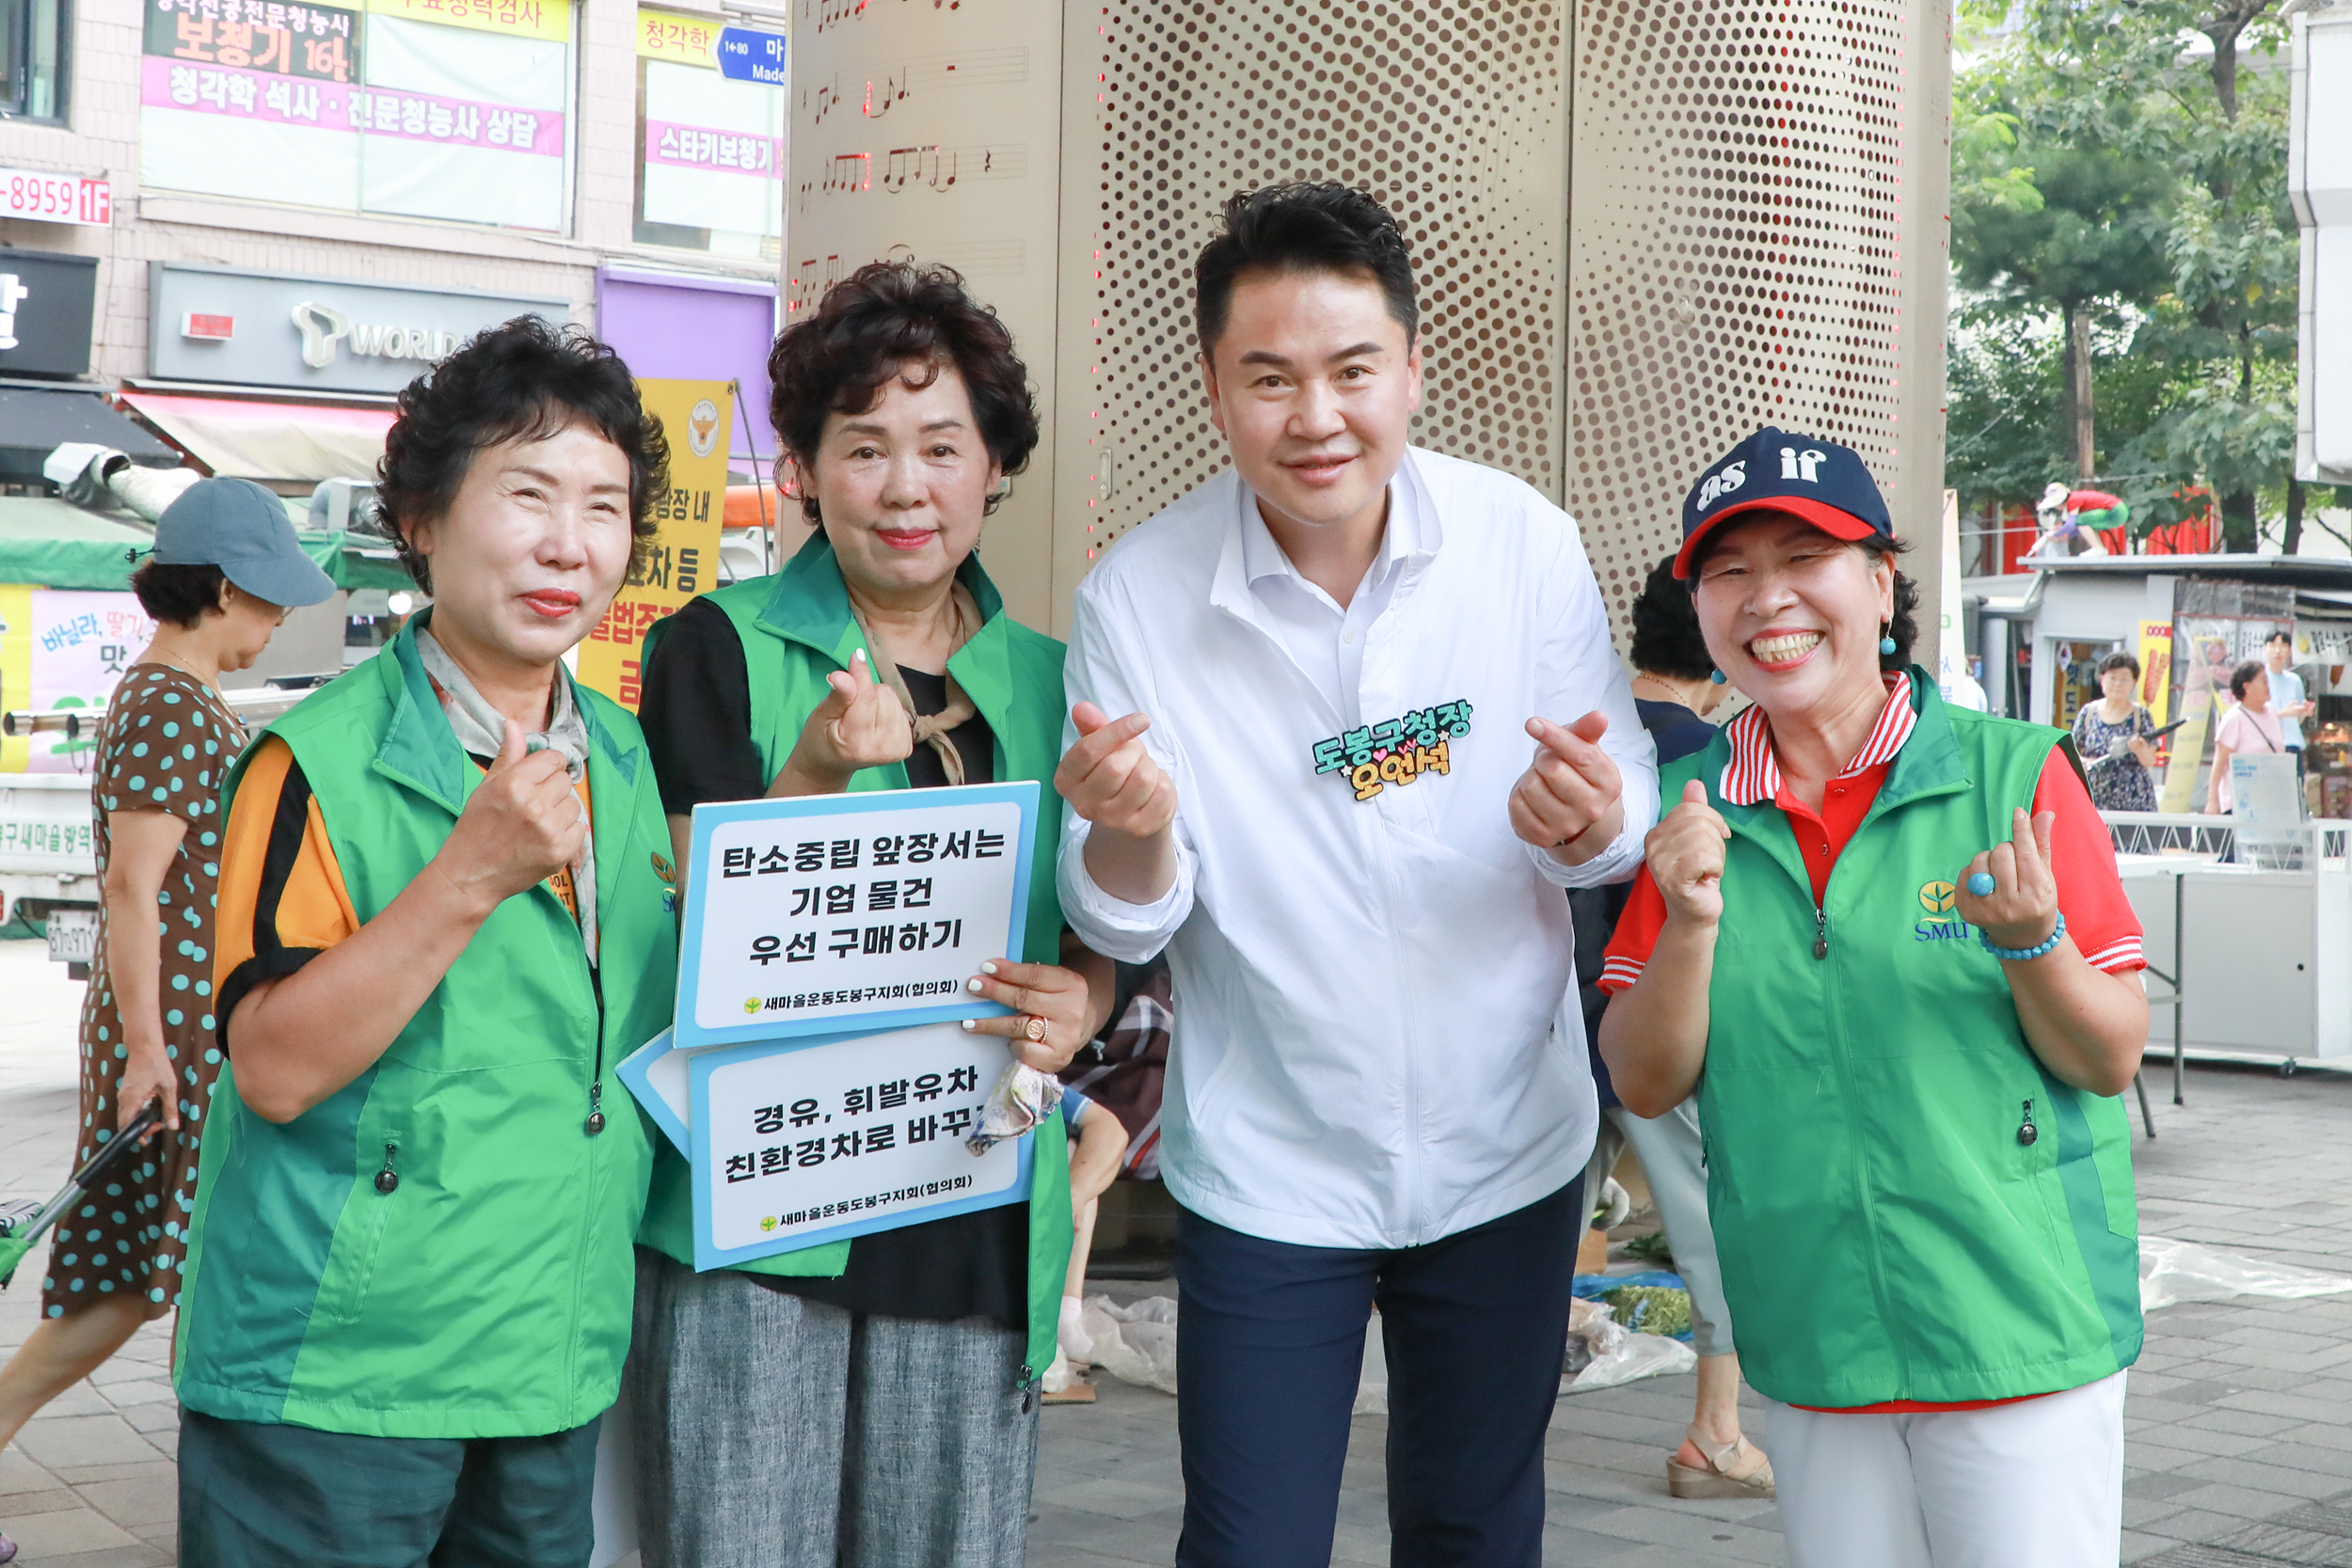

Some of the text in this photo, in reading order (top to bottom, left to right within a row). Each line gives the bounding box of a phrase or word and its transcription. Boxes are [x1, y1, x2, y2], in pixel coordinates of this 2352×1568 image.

[645, 20, 709, 55] 청각학
[169, 66, 537, 149] 청각학 석사 전문청능사 상담
[81, 182, 109, 222] 1F
[349, 325, 459, 360] WORLD
[693, 490, 710, 522] 내
[677, 547, 699, 593] 등
[101, 644, 127, 674] 맛
[1312, 699, 1473, 775] 도봉구청장
[1351, 741, 1450, 800] 오언석
[723, 829, 1005, 879] 탄소중립 앞장서는
[790, 878, 932, 917] 기업 물건
[750, 919, 962, 966] 우선 구매하기
[1915, 922, 1970, 942] SMU
[764, 979, 959, 1012] 새마을운동도봉구지회(협의회)
[754, 1065, 978, 1134] 경유, 휘발유차
[725, 1104, 984, 1184] 친환경차로 바꾸
[779, 1174, 973, 1227] 새마을운동도봉구지회(협의회)
